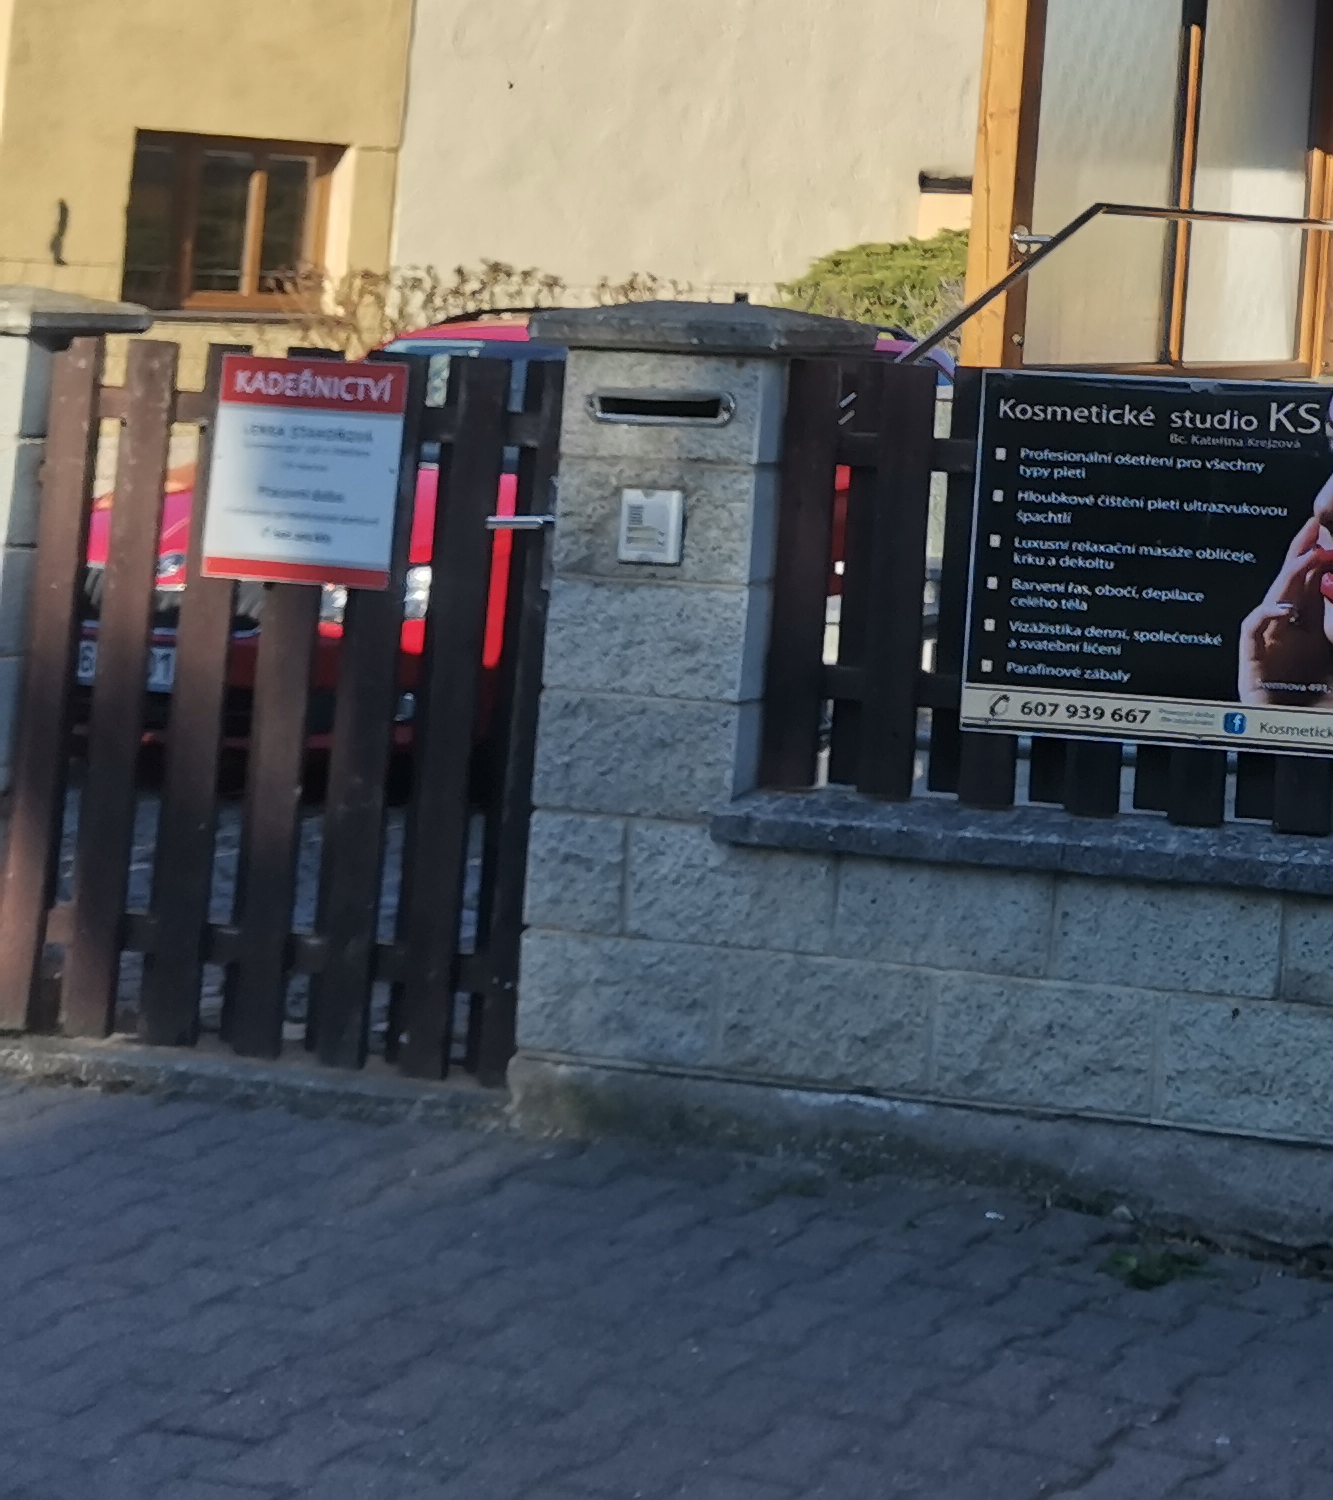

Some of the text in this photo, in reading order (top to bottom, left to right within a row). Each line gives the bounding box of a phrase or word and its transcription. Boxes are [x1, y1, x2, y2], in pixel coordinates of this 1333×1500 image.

[234, 368, 394, 403] KADEŘNICTVÍ
[999, 398, 1321, 434] Kosmetické studio KS
[1019, 464, 1086, 480] typy pleti
[1020, 448, 1266, 474] Profesionální ošetření pro všechny
[1017, 490, 1288, 517] Hloubkové čištění pleti ultrazvukovou
[1014, 536, 1070, 550] Luxusní
[1072, 541, 1136, 555] relaxační
[1139, 545, 1194, 558] masáže
[1013, 552, 1115, 570] krku a dekoltu
[1011, 578, 1066, 593] Barvení
[1142, 587, 1205, 602] depilace
[1010, 595, 1058, 609] celého
[1007, 638, 1018, 649] a
[1018, 640, 1081, 653] svatební
[1133, 630, 1222, 646] společenské
[1083, 667, 1131, 683] zábaly
[1020, 700, 1059, 717] 607
[1065, 703, 1105, 720] 939
[1110, 706, 1151, 723] 667
